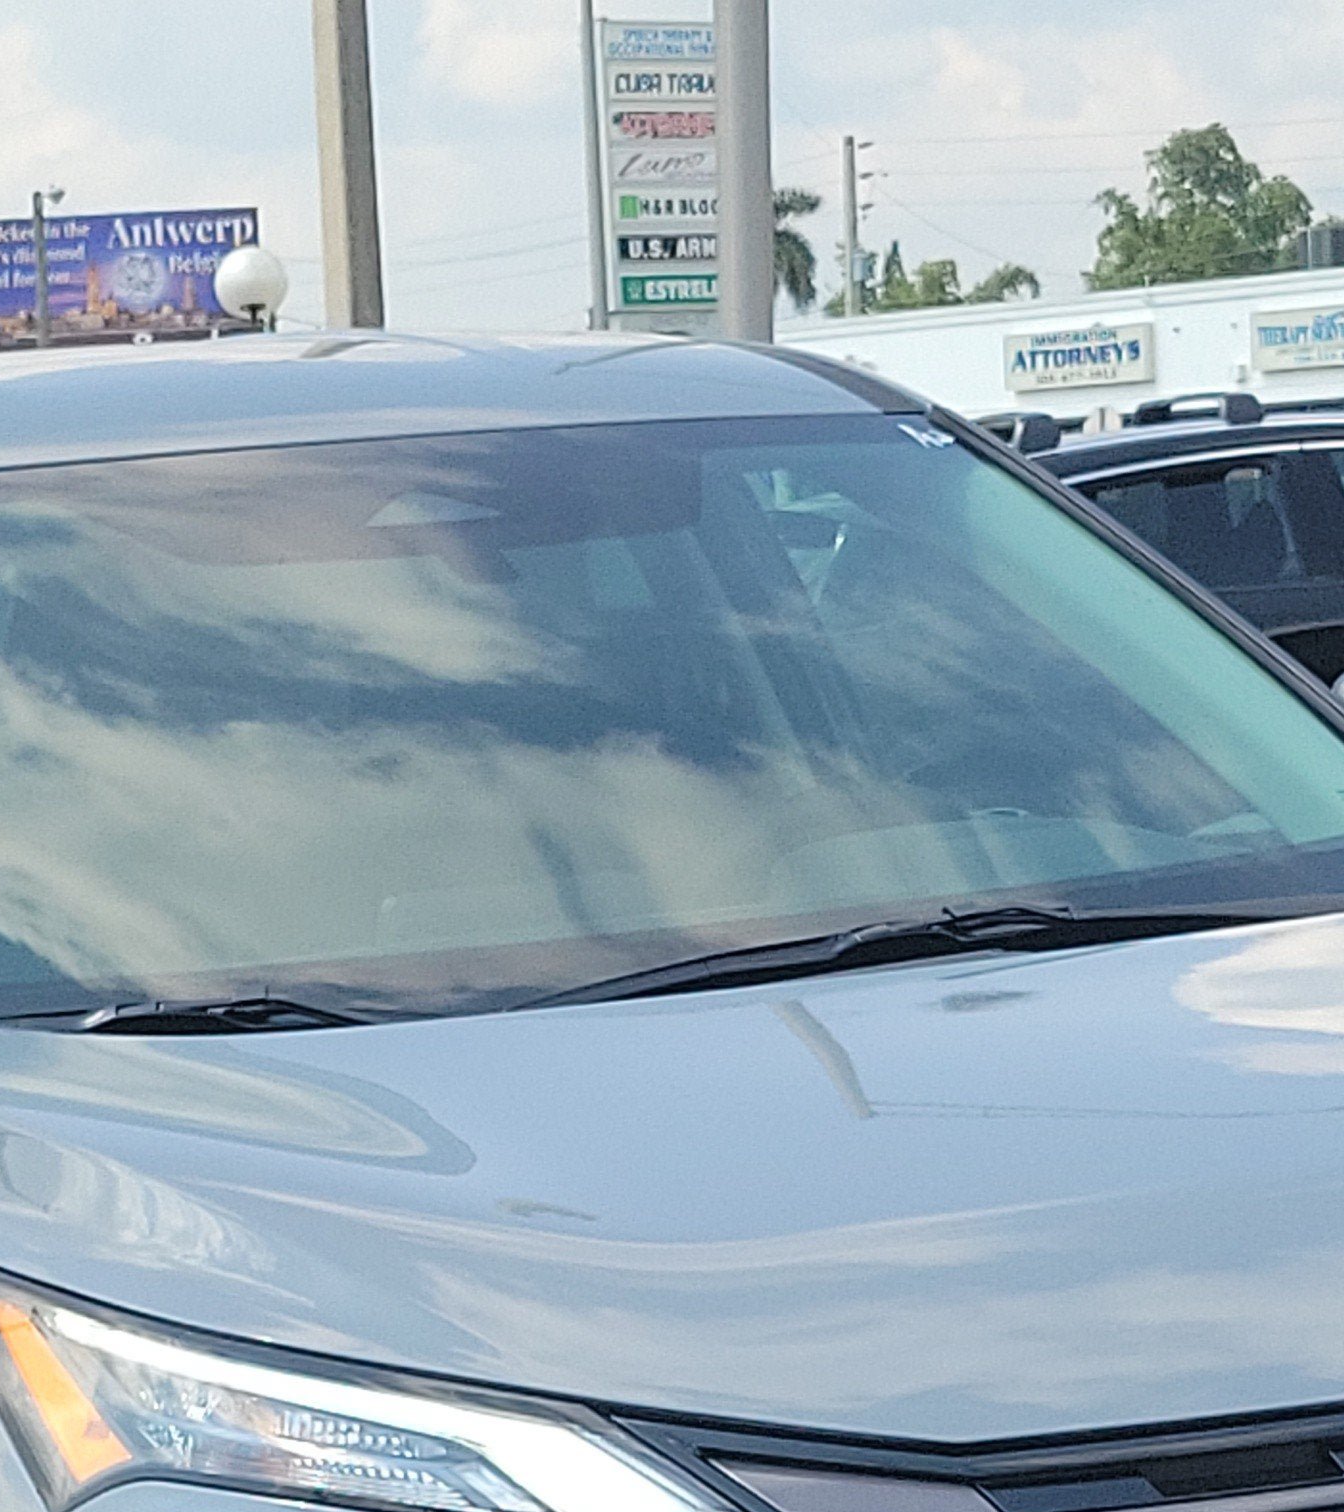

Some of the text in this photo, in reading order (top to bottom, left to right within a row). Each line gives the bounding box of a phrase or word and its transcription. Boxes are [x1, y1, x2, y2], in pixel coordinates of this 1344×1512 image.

[615, 72, 716, 93] CUBA TRAV
[679, 199, 718, 215] BLOC
[63, 219, 91, 239] the
[107, 216, 254, 249] Antwerp
[628, 237, 717, 259] U.S. ARM
